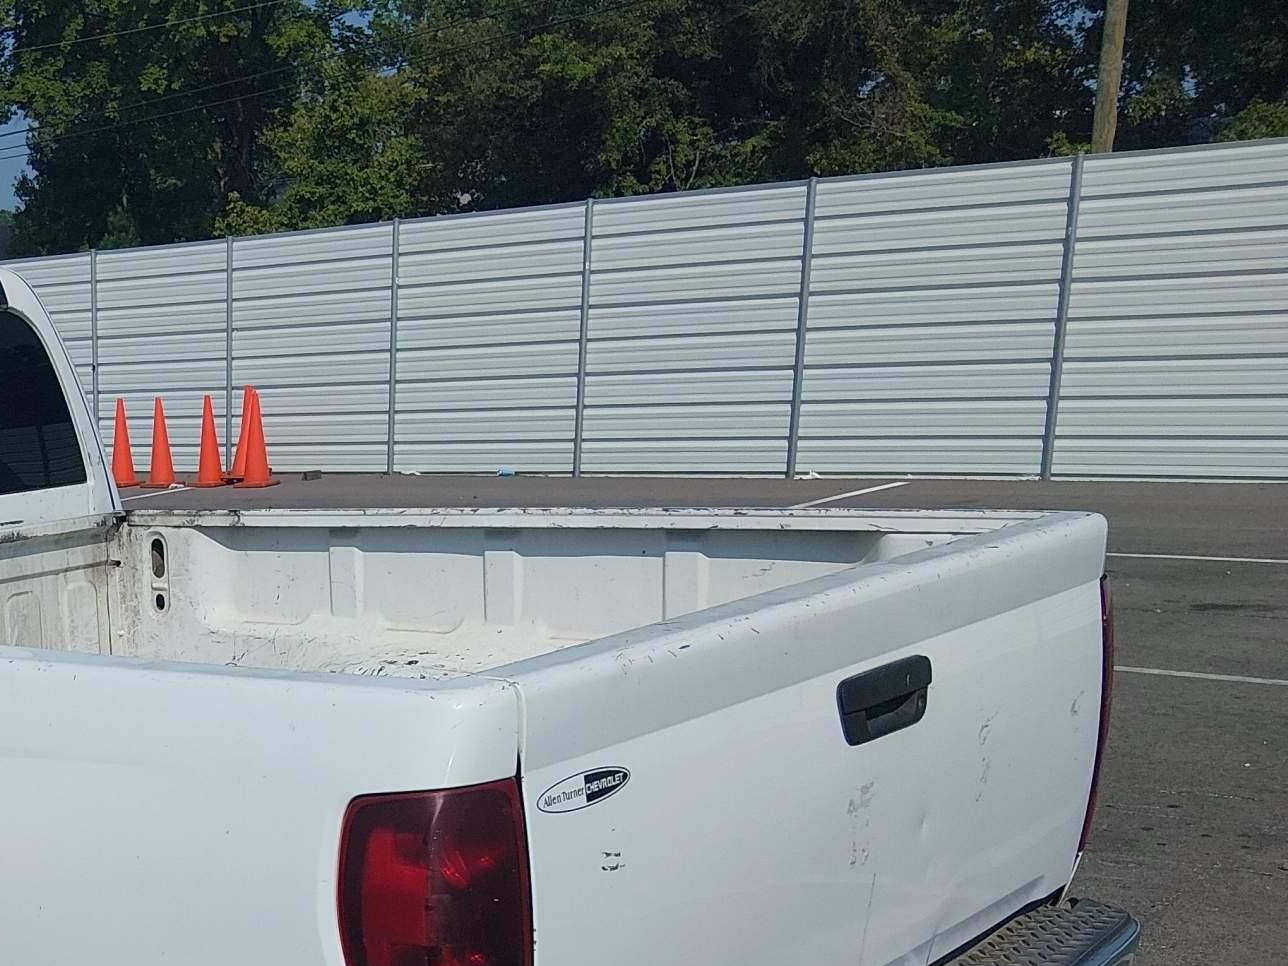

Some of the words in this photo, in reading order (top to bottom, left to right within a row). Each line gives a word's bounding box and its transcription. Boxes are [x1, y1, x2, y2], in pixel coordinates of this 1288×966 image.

[543, 793, 562, 809] Allen
[561, 786, 585, 803] Turner
[585, 772, 625, 795] CHEVROLET
